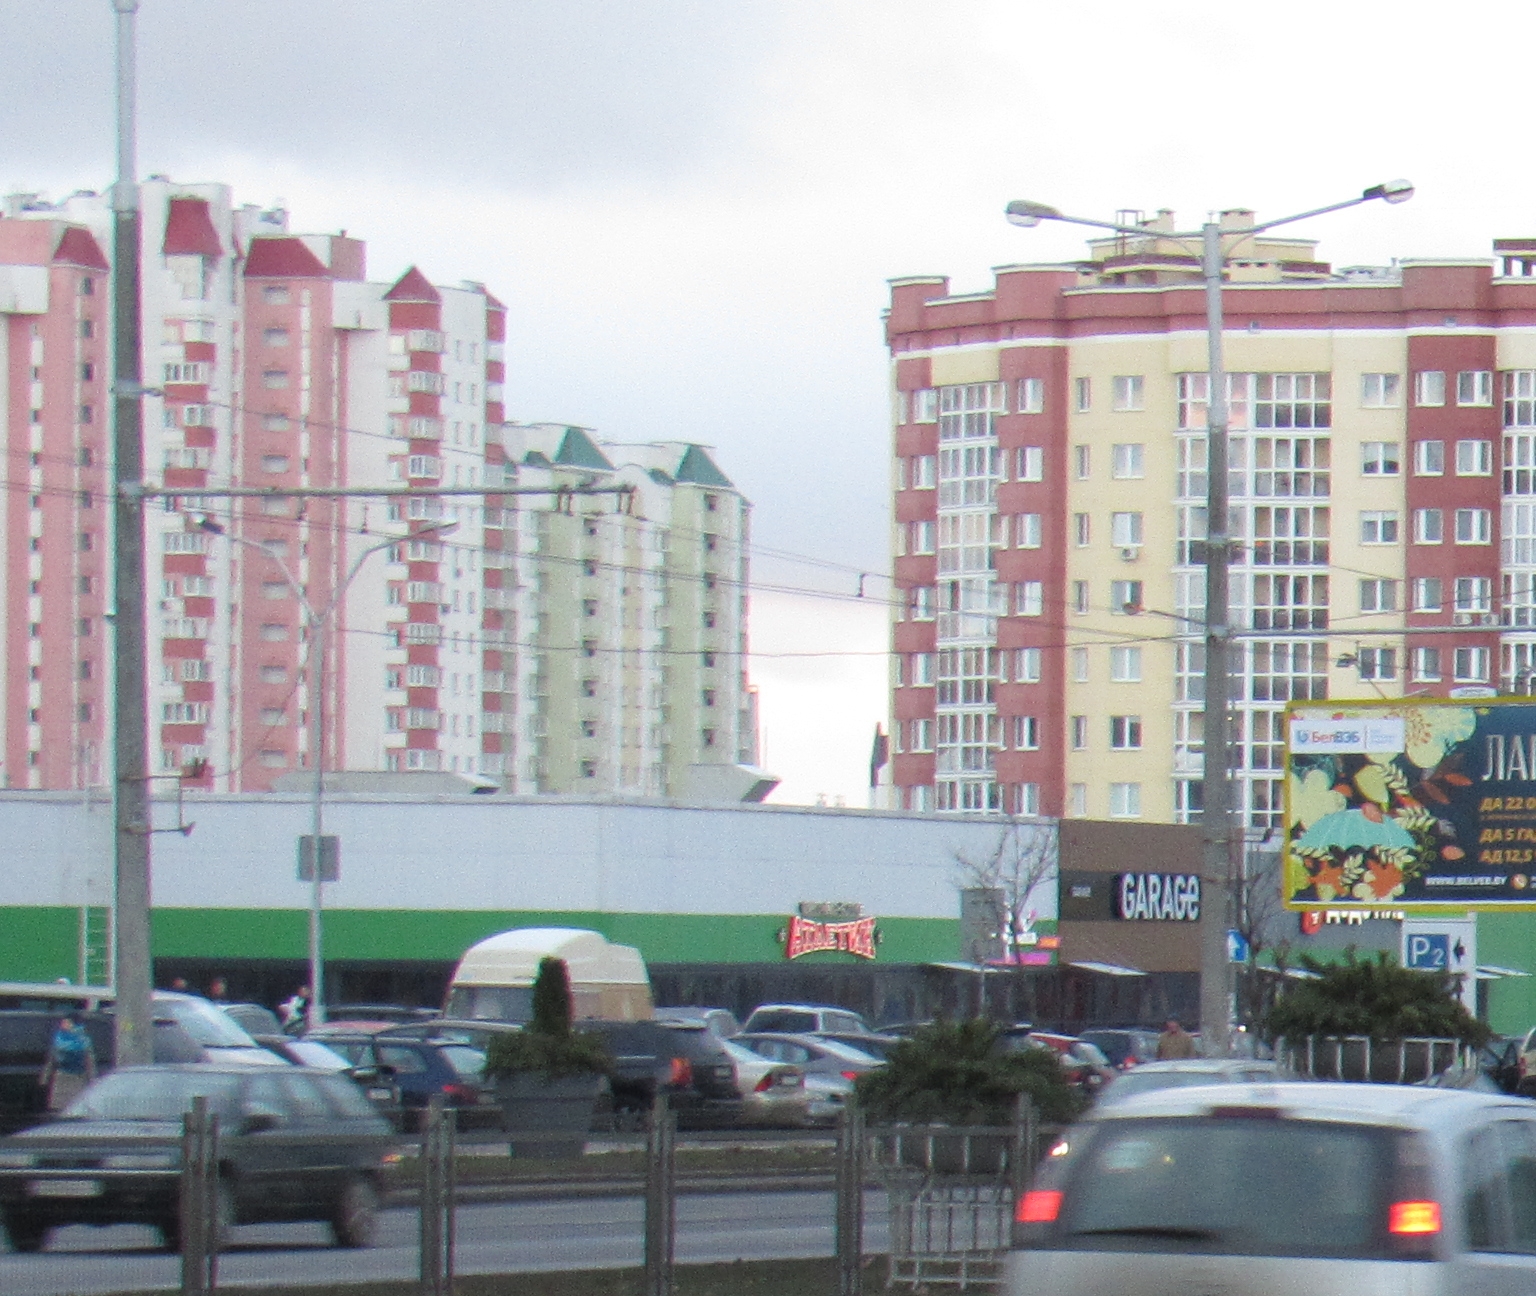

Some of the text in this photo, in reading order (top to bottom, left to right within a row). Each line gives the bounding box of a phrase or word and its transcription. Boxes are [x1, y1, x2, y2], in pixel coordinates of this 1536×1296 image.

[1480, 797, 1503, 812] ДА
[1504, 797, 1524, 811] 22
[1479, 828, 1503, 843] ДА
[1505, 829, 1515, 841] 5
[1479, 849, 1503, 864] АД
